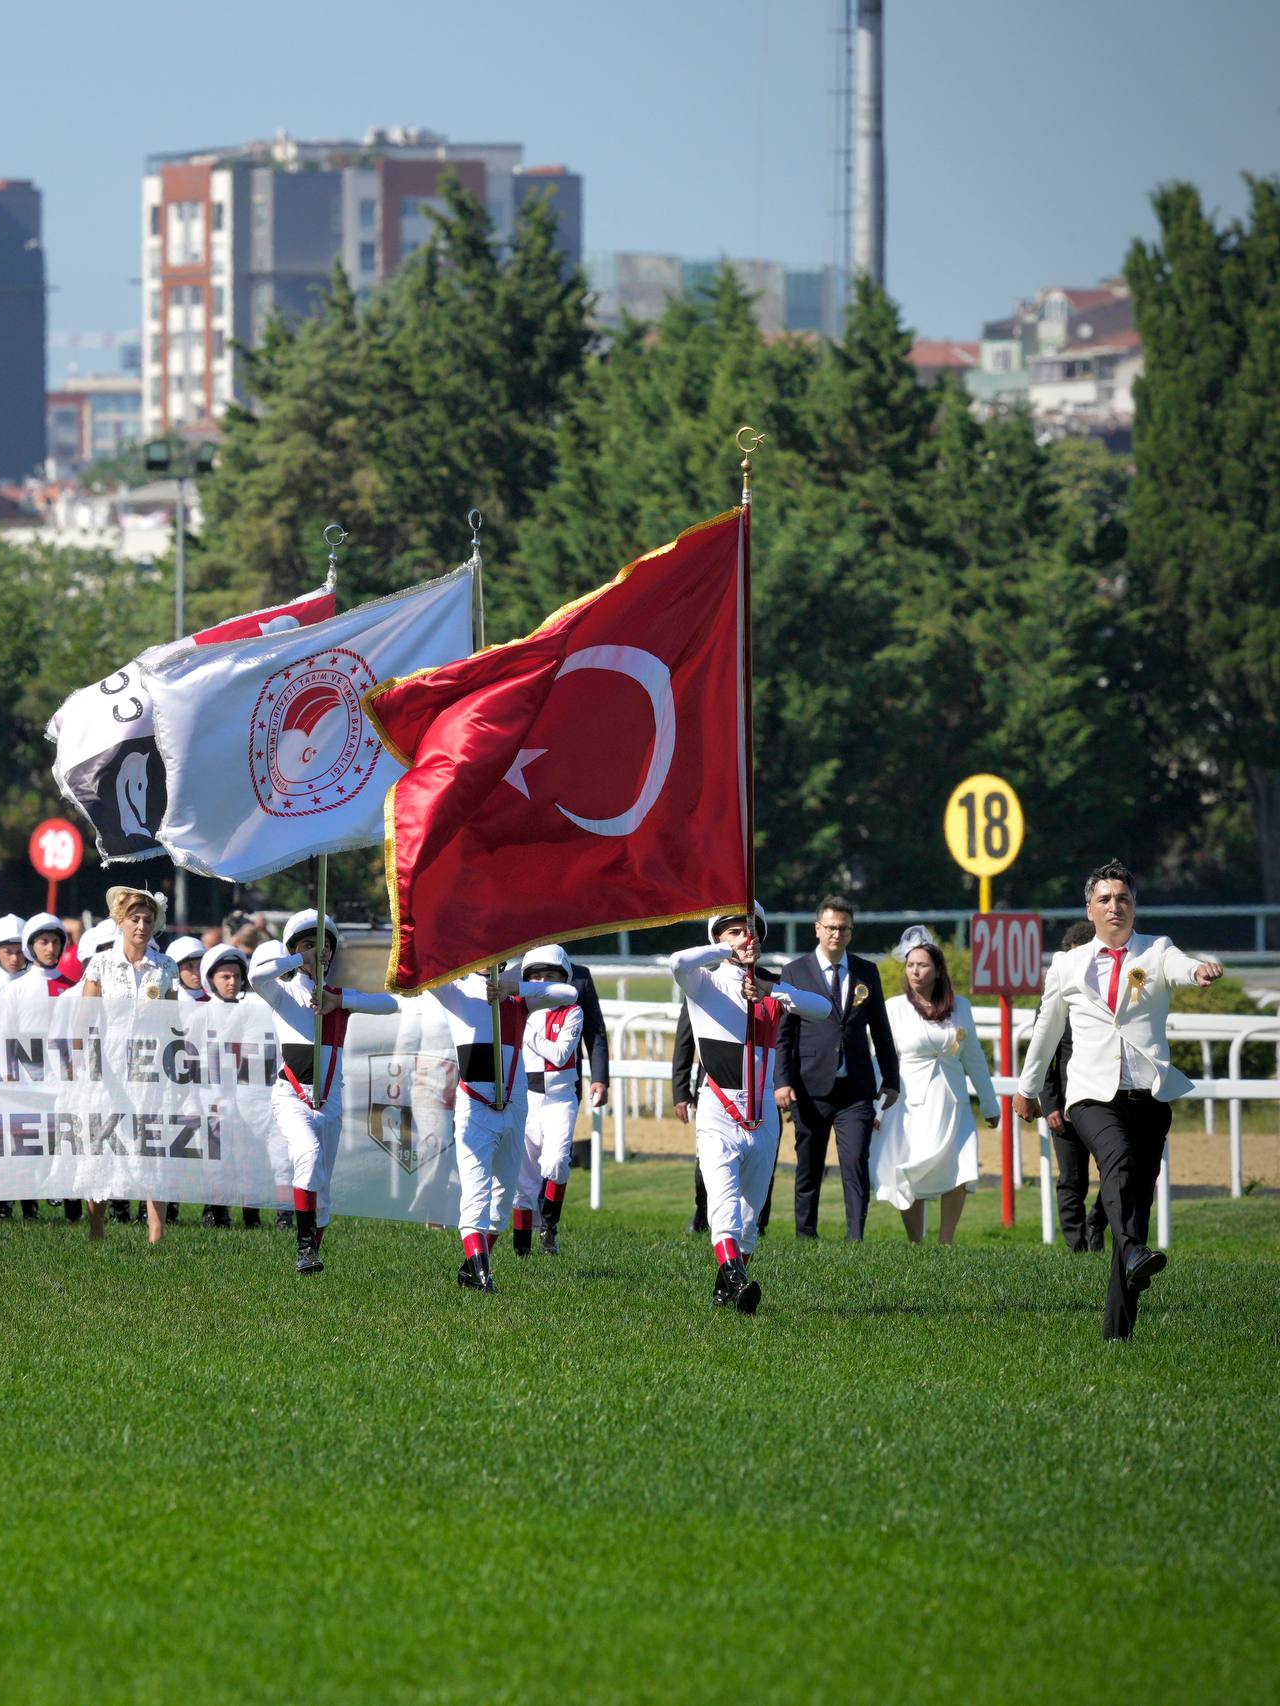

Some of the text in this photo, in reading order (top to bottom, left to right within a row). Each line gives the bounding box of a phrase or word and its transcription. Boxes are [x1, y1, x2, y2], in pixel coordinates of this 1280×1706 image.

[299, 673, 327, 688] TARIM
[332, 674, 343, 686] VE
[331, 718, 359, 779] BAKANLIĞI
[39, 829, 75, 870] 19
[958, 791, 1010, 859] 18
[974, 919, 1041, 988] 2100
[127, 1026, 277, 1087] EĞİTİ
